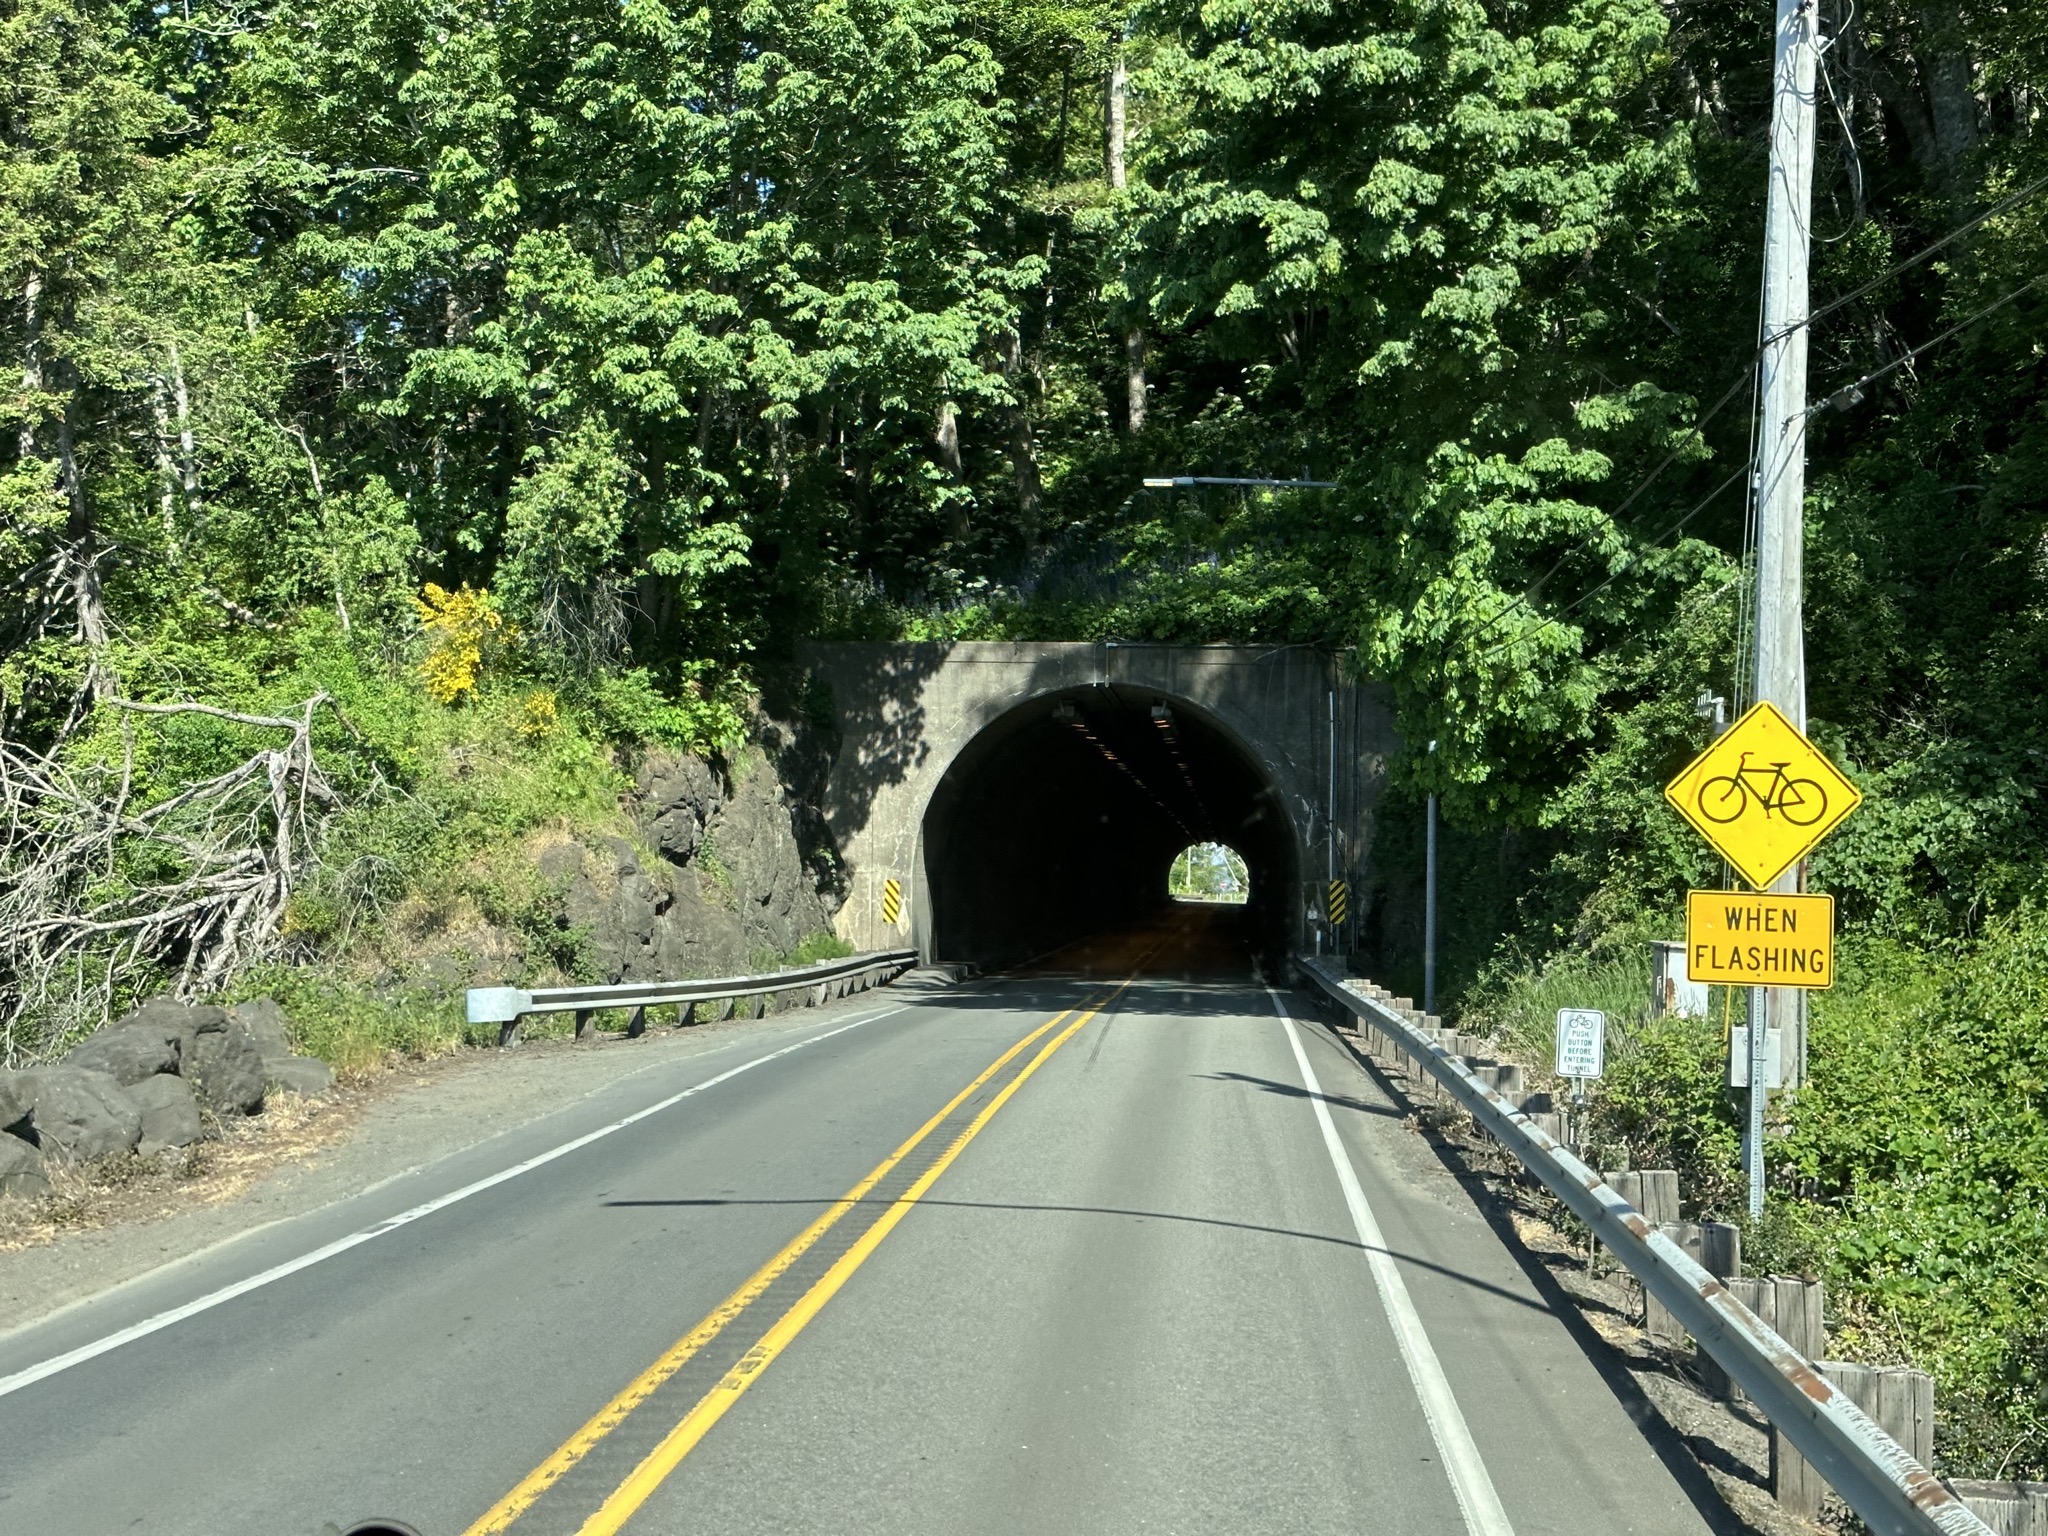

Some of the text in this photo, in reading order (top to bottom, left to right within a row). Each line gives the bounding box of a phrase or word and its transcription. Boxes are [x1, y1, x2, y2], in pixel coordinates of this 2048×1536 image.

[1725, 907, 1796, 933] WHEN
[1696, 945, 1824, 973] FLASHING
[1572, 1030, 1589, 1038] PUSH
[1564, 1056, 1595, 1064] ENTERING
[1567, 1064, 1591, 1072] TUNNEL
